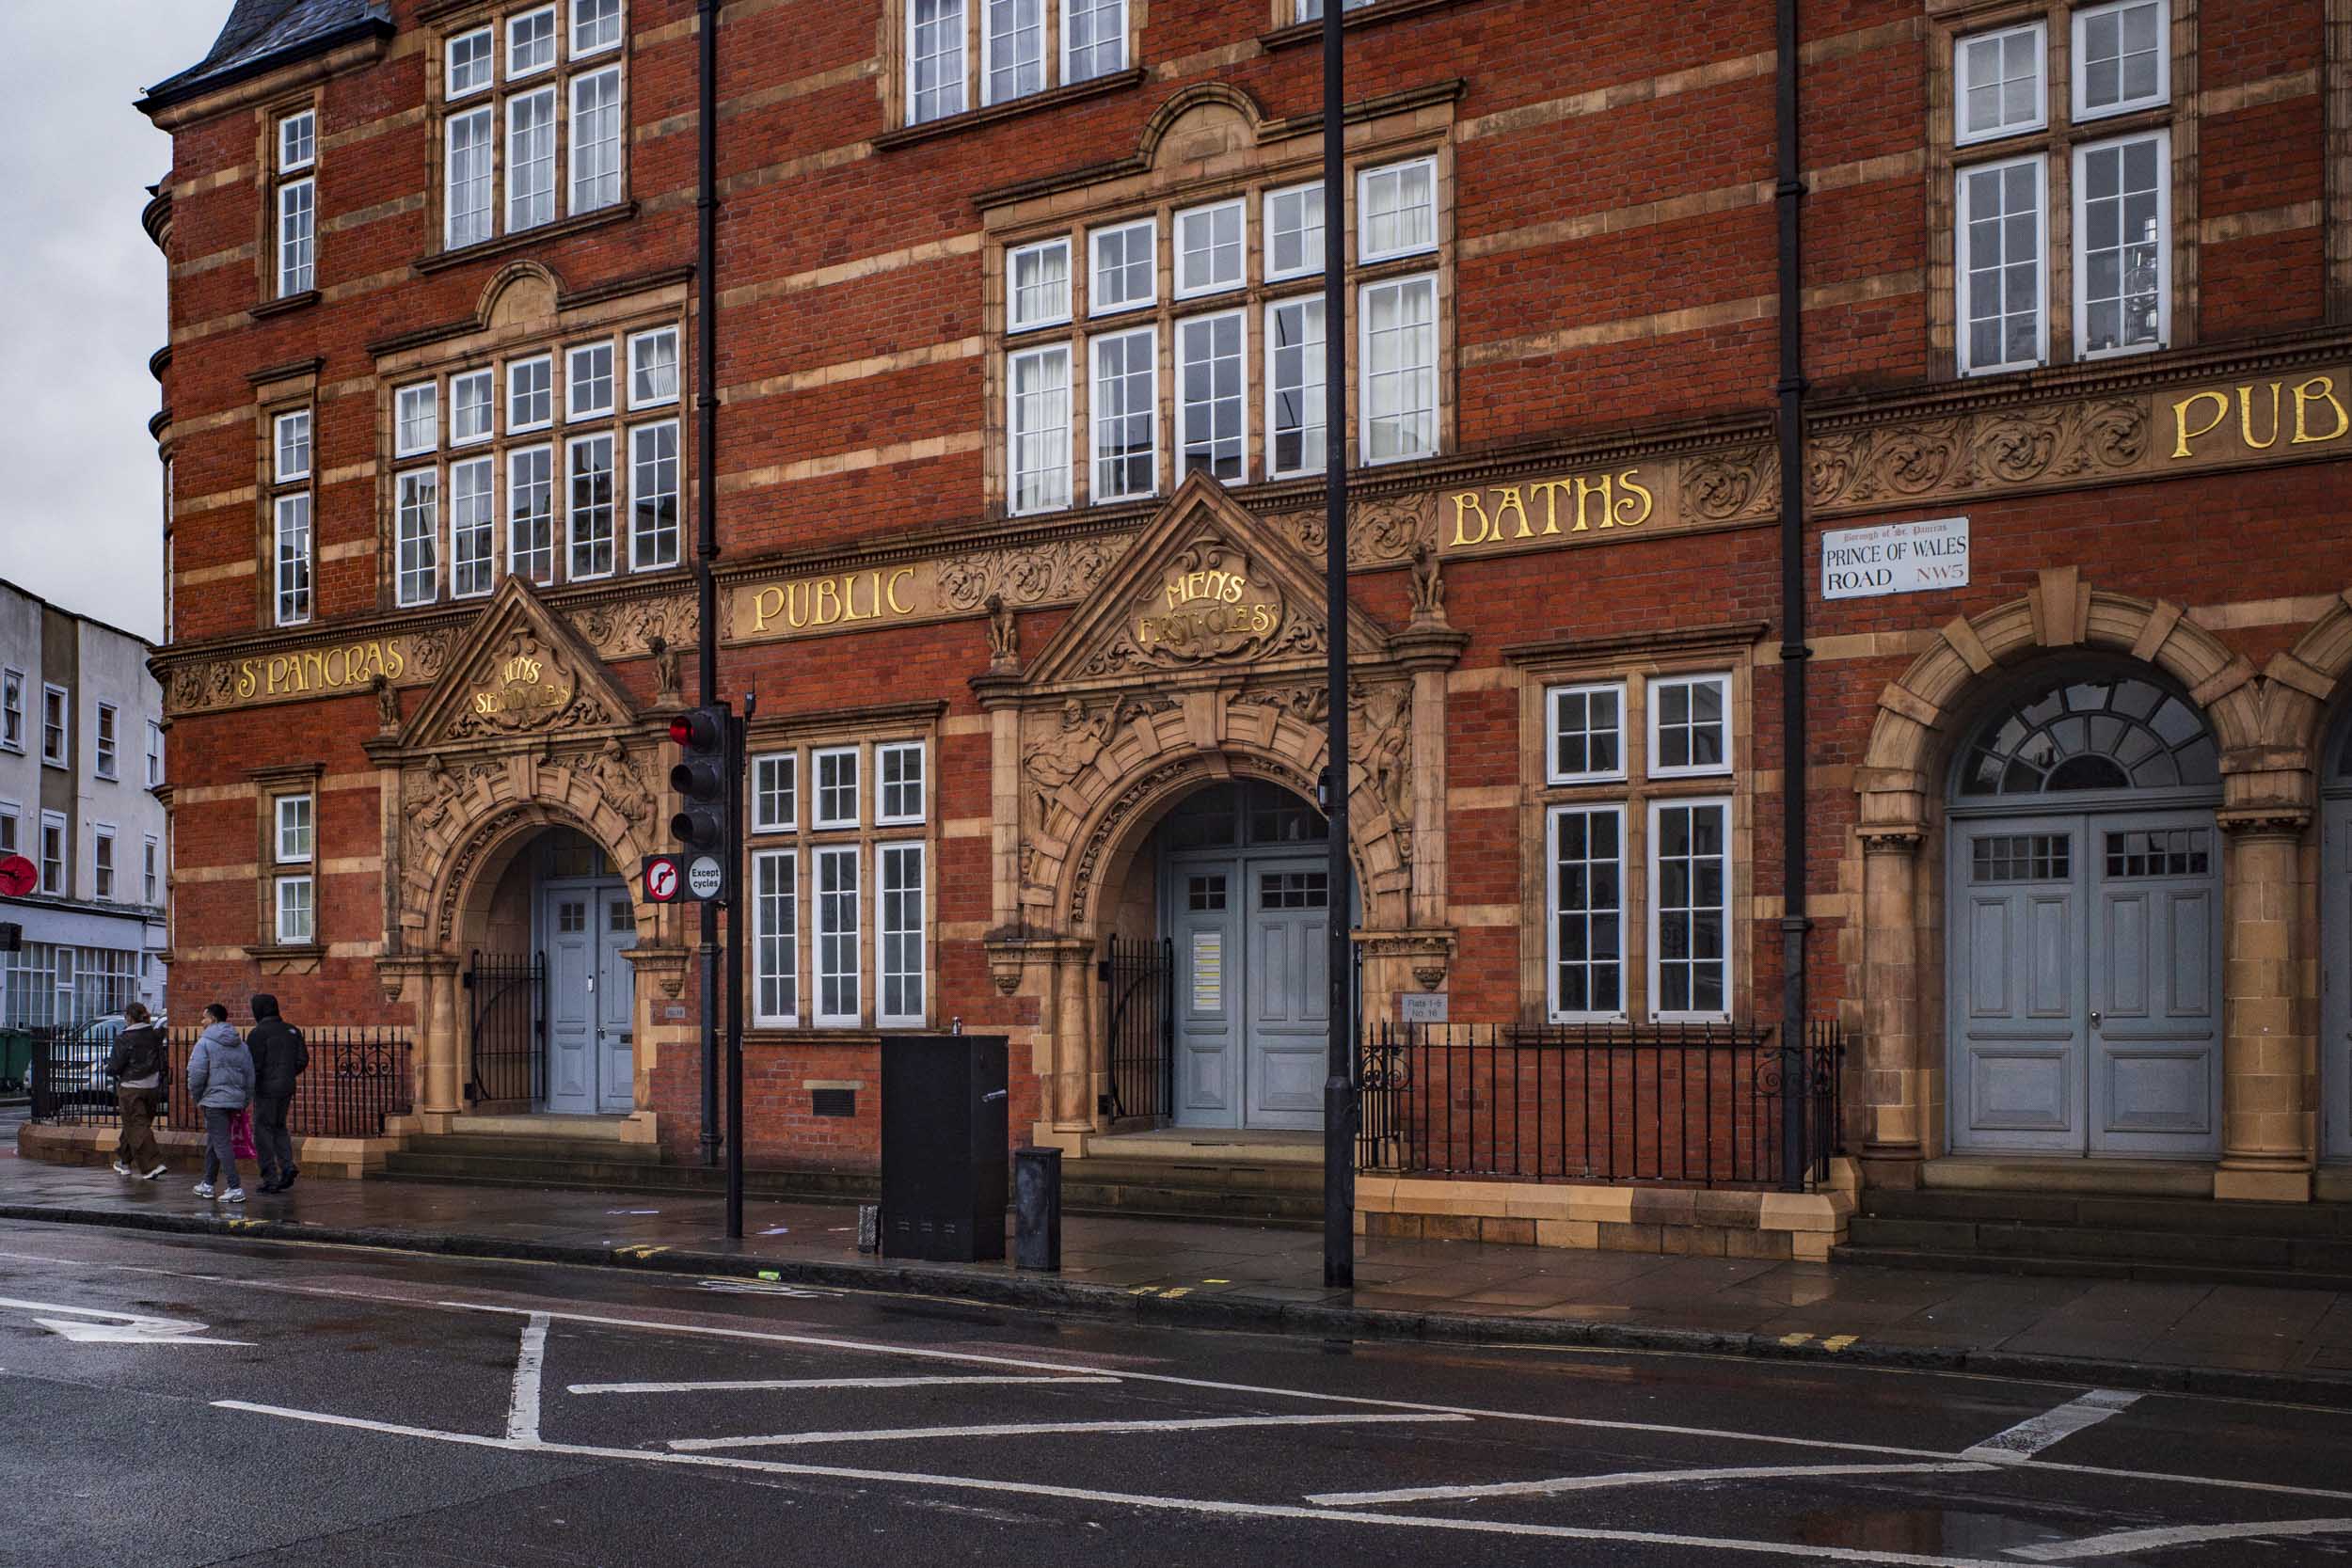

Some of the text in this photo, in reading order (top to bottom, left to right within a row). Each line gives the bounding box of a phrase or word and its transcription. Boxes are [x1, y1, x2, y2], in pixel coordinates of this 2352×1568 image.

[1449, 468, 1654, 546] BATHS
[1844, 531, 1879, 543] Borough
[1882, 528, 1890, 538] of
[1914, 524, 1947, 535] Pancras
[1827, 536, 1966, 567] PRINCE OF WALES
[1167, 570, 1247, 610] MENS
[1828, 564, 1964, 590] ROAD NW5
[753, 565, 916, 632] PUBLIC
[267, 640, 405, 694] PANCRAS
[691, 868, 720, 879] Except
[692, 879, 719, 889] cycles
